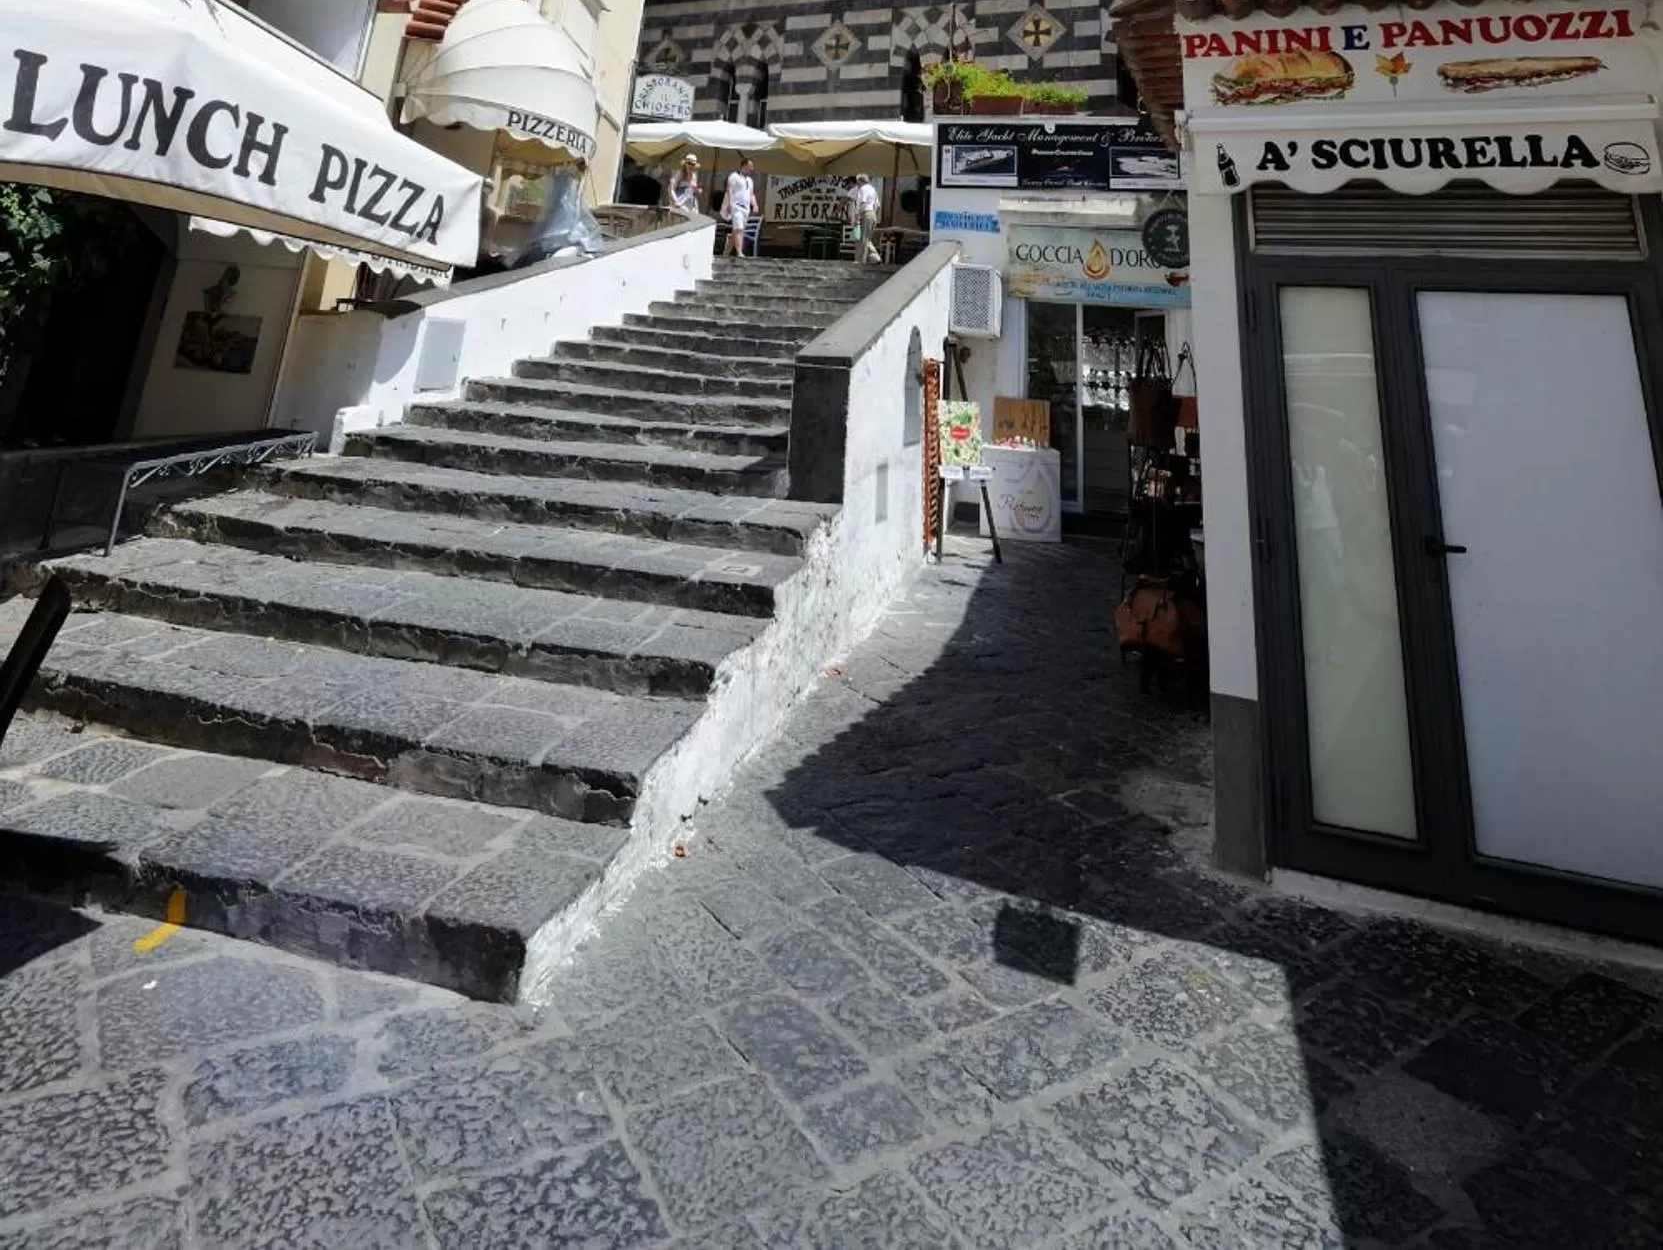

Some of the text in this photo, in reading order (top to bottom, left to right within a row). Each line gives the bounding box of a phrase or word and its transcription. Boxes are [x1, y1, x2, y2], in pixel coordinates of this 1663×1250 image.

[1183, 9, 1634, 58] PANINI E PANUOZZI
[634, 99, 692, 116] CHIOSTRO
[506, 110, 586, 153] PIZZERIA
[976, 128, 1015, 142] Yacht
[1016, 127, 1099, 148] Management
[3, 48, 445, 245] LUNCH PIZZA
[1256, 134, 1600, 171] A' SCIURELLA
[774, 202, 850, 220] RISTORAN
[1015, 243, 1084, 264] GOCCIA
